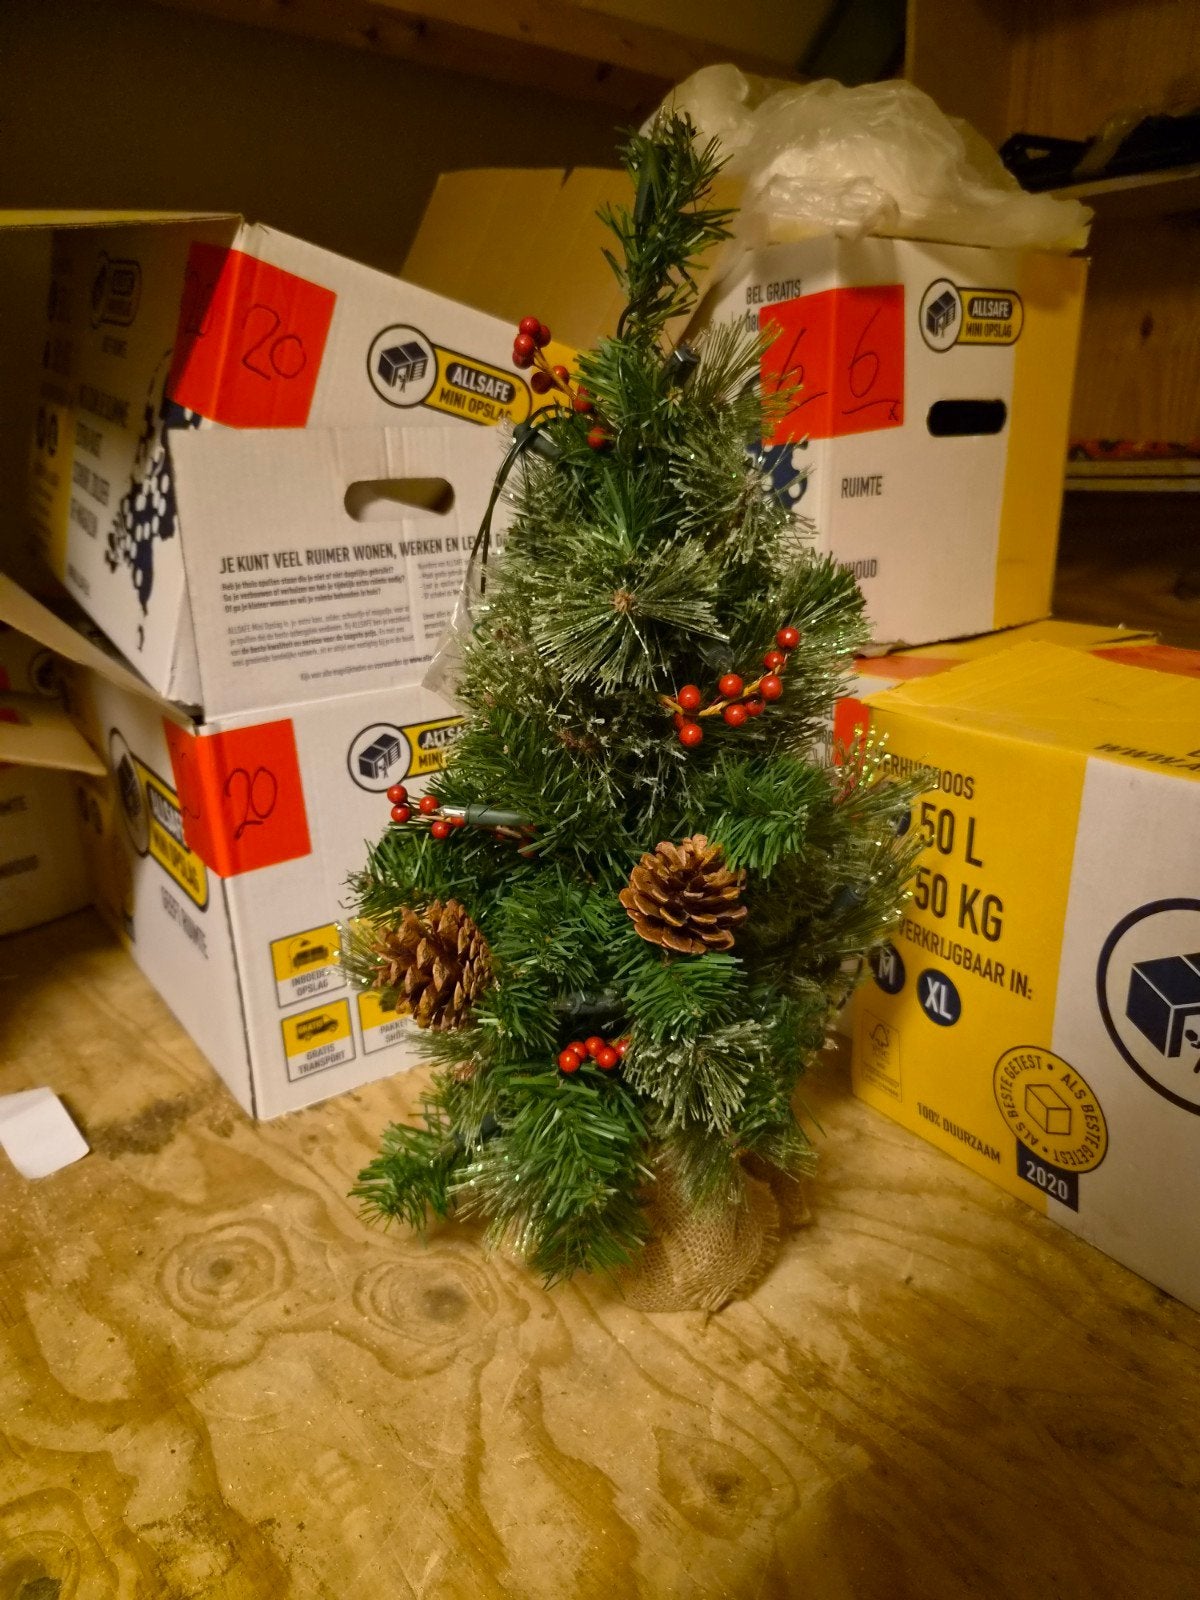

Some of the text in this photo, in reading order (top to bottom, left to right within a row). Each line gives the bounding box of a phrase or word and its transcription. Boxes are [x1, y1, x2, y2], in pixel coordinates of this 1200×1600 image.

[746, 279, 801, 305] BEL GRATIS
[972, 299, 1009, 319] ALLSAFE
[242, 303, 307, 381] 20
[966, 322, 1012, 338] MINI OPSLAG
[848, 306, 879, 399] 6
[438, 387, 466, 411] MINI
[451, 365, 511, 402] ALLSAFE
[841, 475, 883, 499] RUIMTE
[219, 557, 235, 574] JE
[236, 553, 270, 572] KUNT
[272, 551, 302, 569] VEEL
[305, 547, 350, 567] RUIMER
[352, 542, 398, 561] WONEN,
[398, 537, 443, 558] WERKEN
[445, 536, 459, 552] EN
[224, 766, 278, 840] 20
[920, 802, 983, 868] 50 L
[914, 865, 1004, 943] 50 KG
[297, 978, 329, 997] OPSLAG
[878, 951, 954, 1021] M XL
[1009, 968, 1033, 1001] IN:
[298, 1050, 346, 1075] TRANSPORT
[306, 1043, 335, 1061] GRATIS
[1000, 1054, 1042, 1146] ALS BESTE GETEST
[917, 1102, 1001, 1165] 100% DUURZAAM
[1053, 1073, 1100, 1167] ALS BESTE GETEST
[1025, 1160, 1069, 1200] 2020
